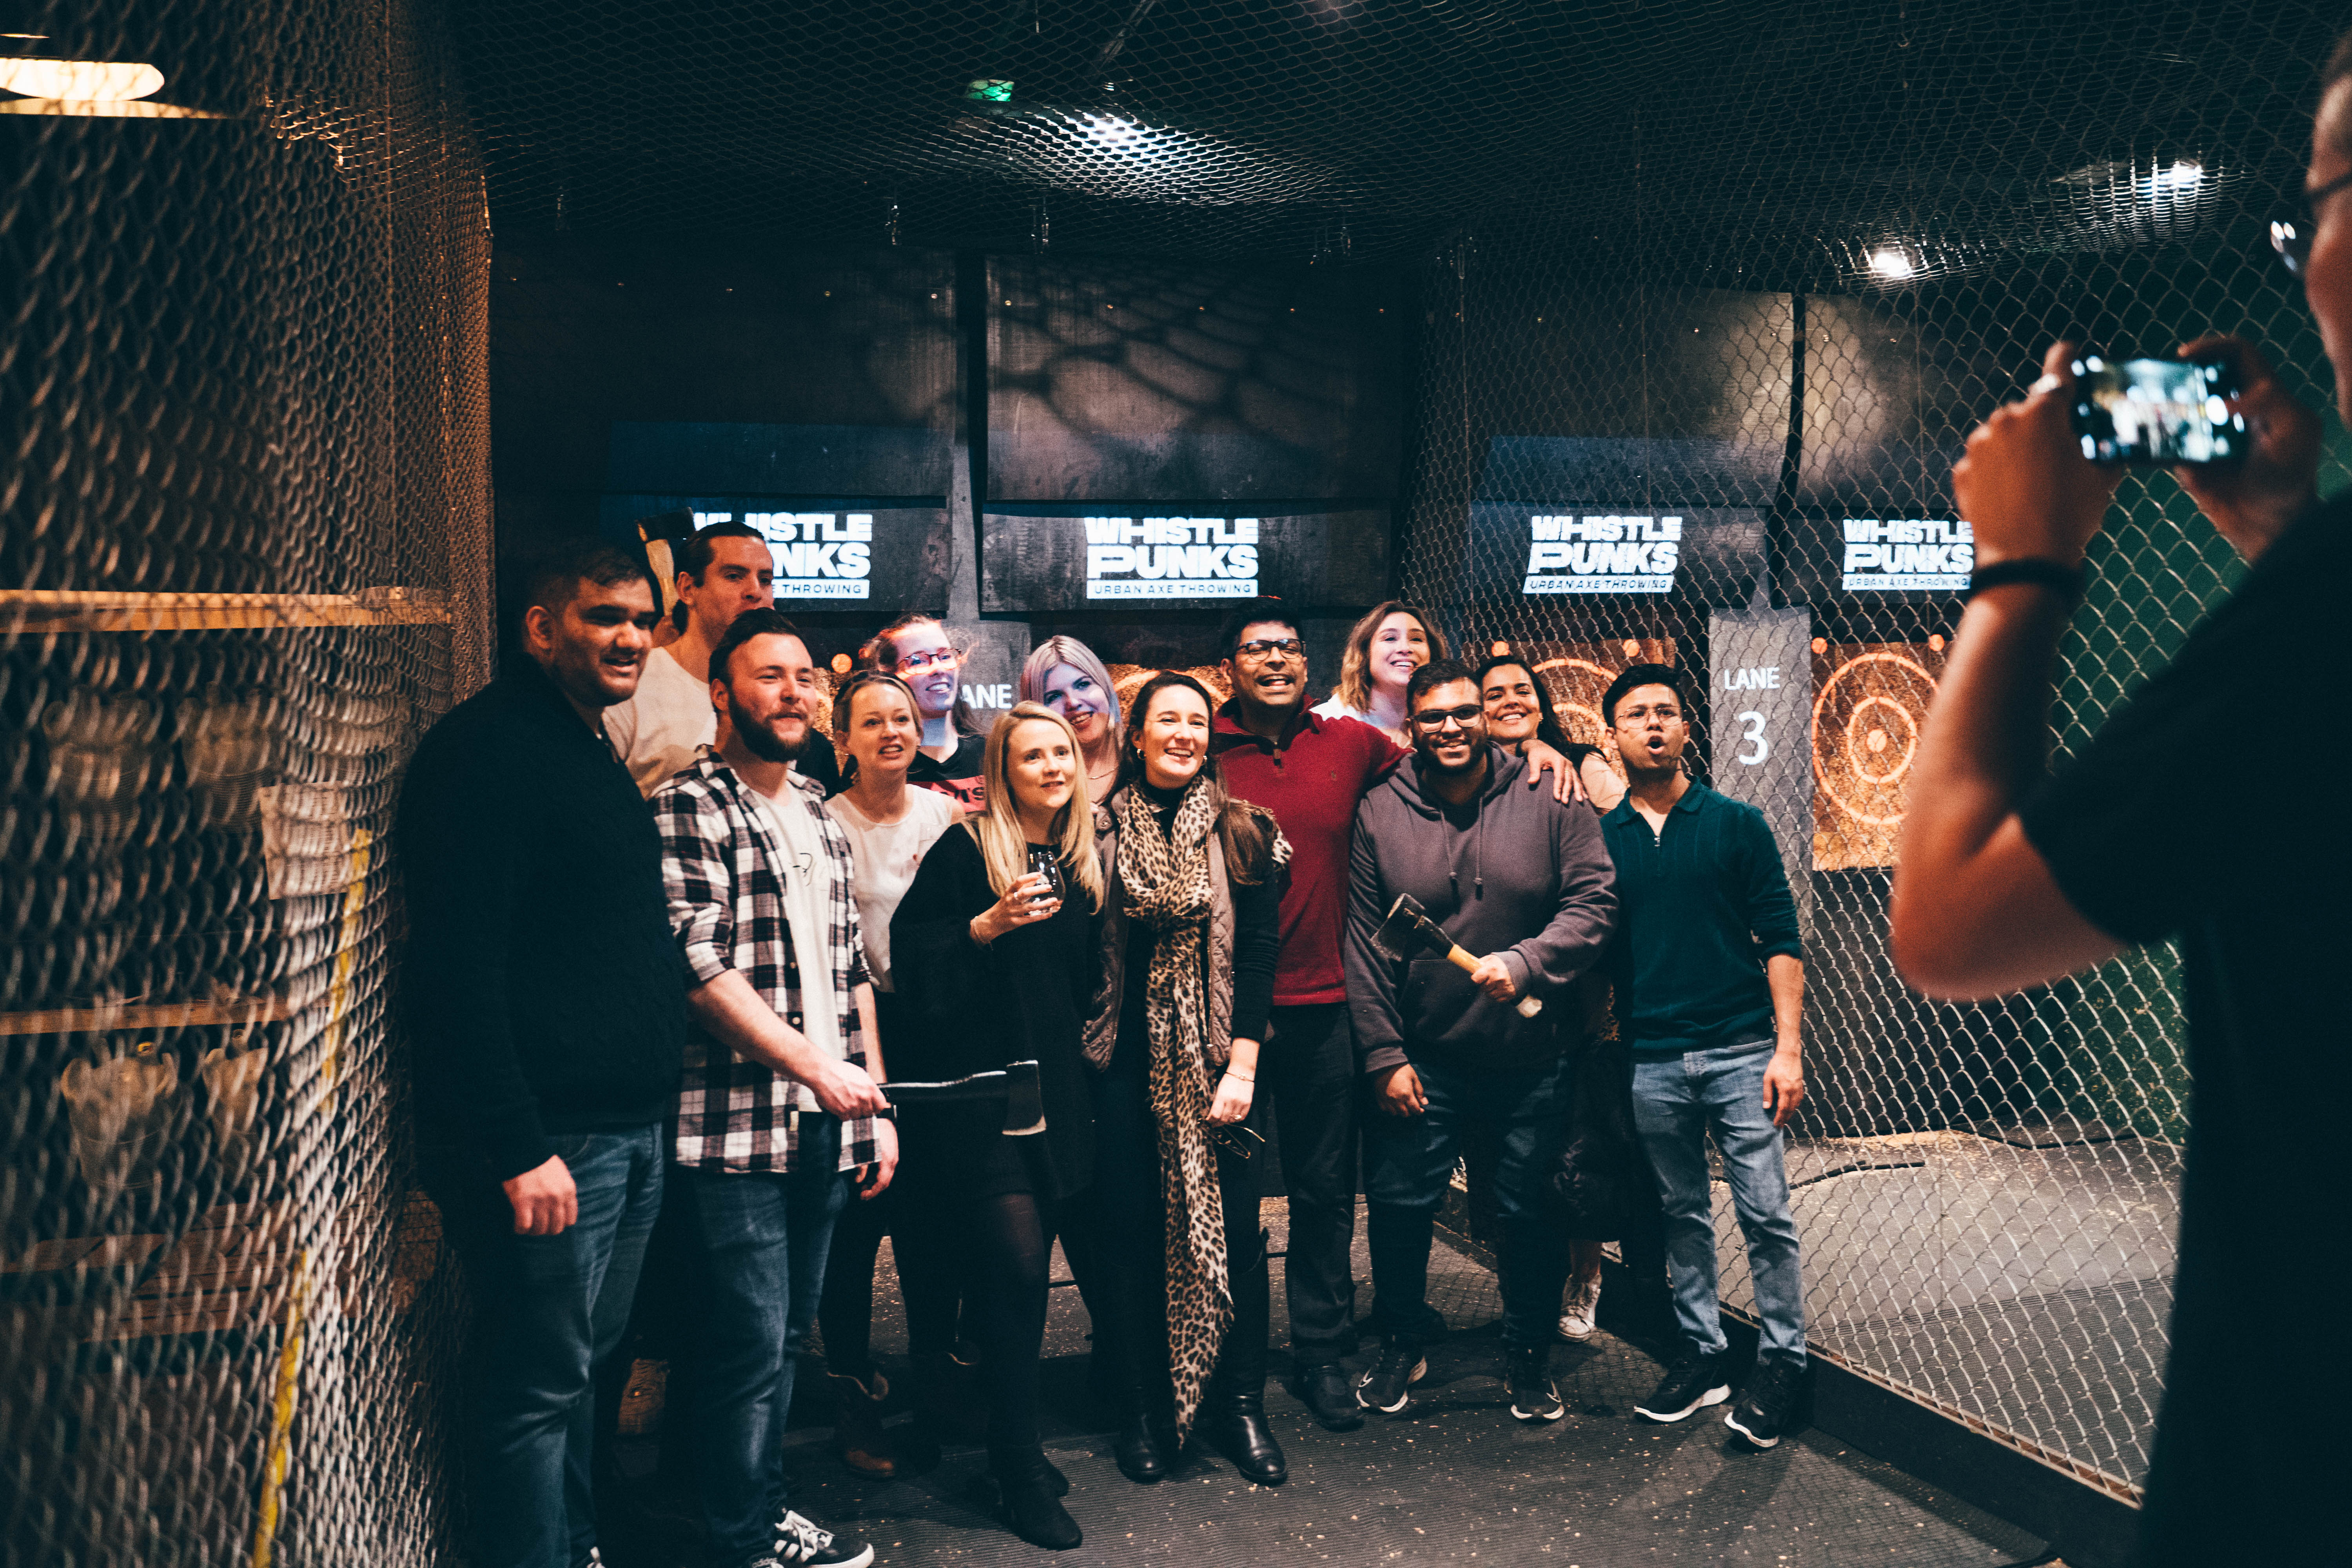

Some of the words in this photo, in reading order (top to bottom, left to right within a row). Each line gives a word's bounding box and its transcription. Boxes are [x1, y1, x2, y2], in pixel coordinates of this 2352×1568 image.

[1084, 517, 1258, 544] WHISTLE
[1532, 515, 1682, 541] WHISTLE
[1843, 519, 1974, 543] WHISTLE
[766, 543, 870, 578] NKS
[1087, 545, 1258, 579] PUNKS
[1527, 541, 1679, 574] PUNKS
[1844, 544, 1974, 573] PUNKS
[782, 584, 861, 593] THROWING
[1095, 585, 1141, 594] URBAN
[1147, 585, 1173, 593] AXE
[1181, 584, 1251, 593] THROWING
[1530, 580, 1574, 589] URBAN
[1576, 580, 1600, 588] AXE
[1605, 579, 1666, 588] THROWING
[1724, 667, 1780, 690] LANE
[961, 684, 1012, 709] ANE
[1739, 711, 1768, 765] 3
